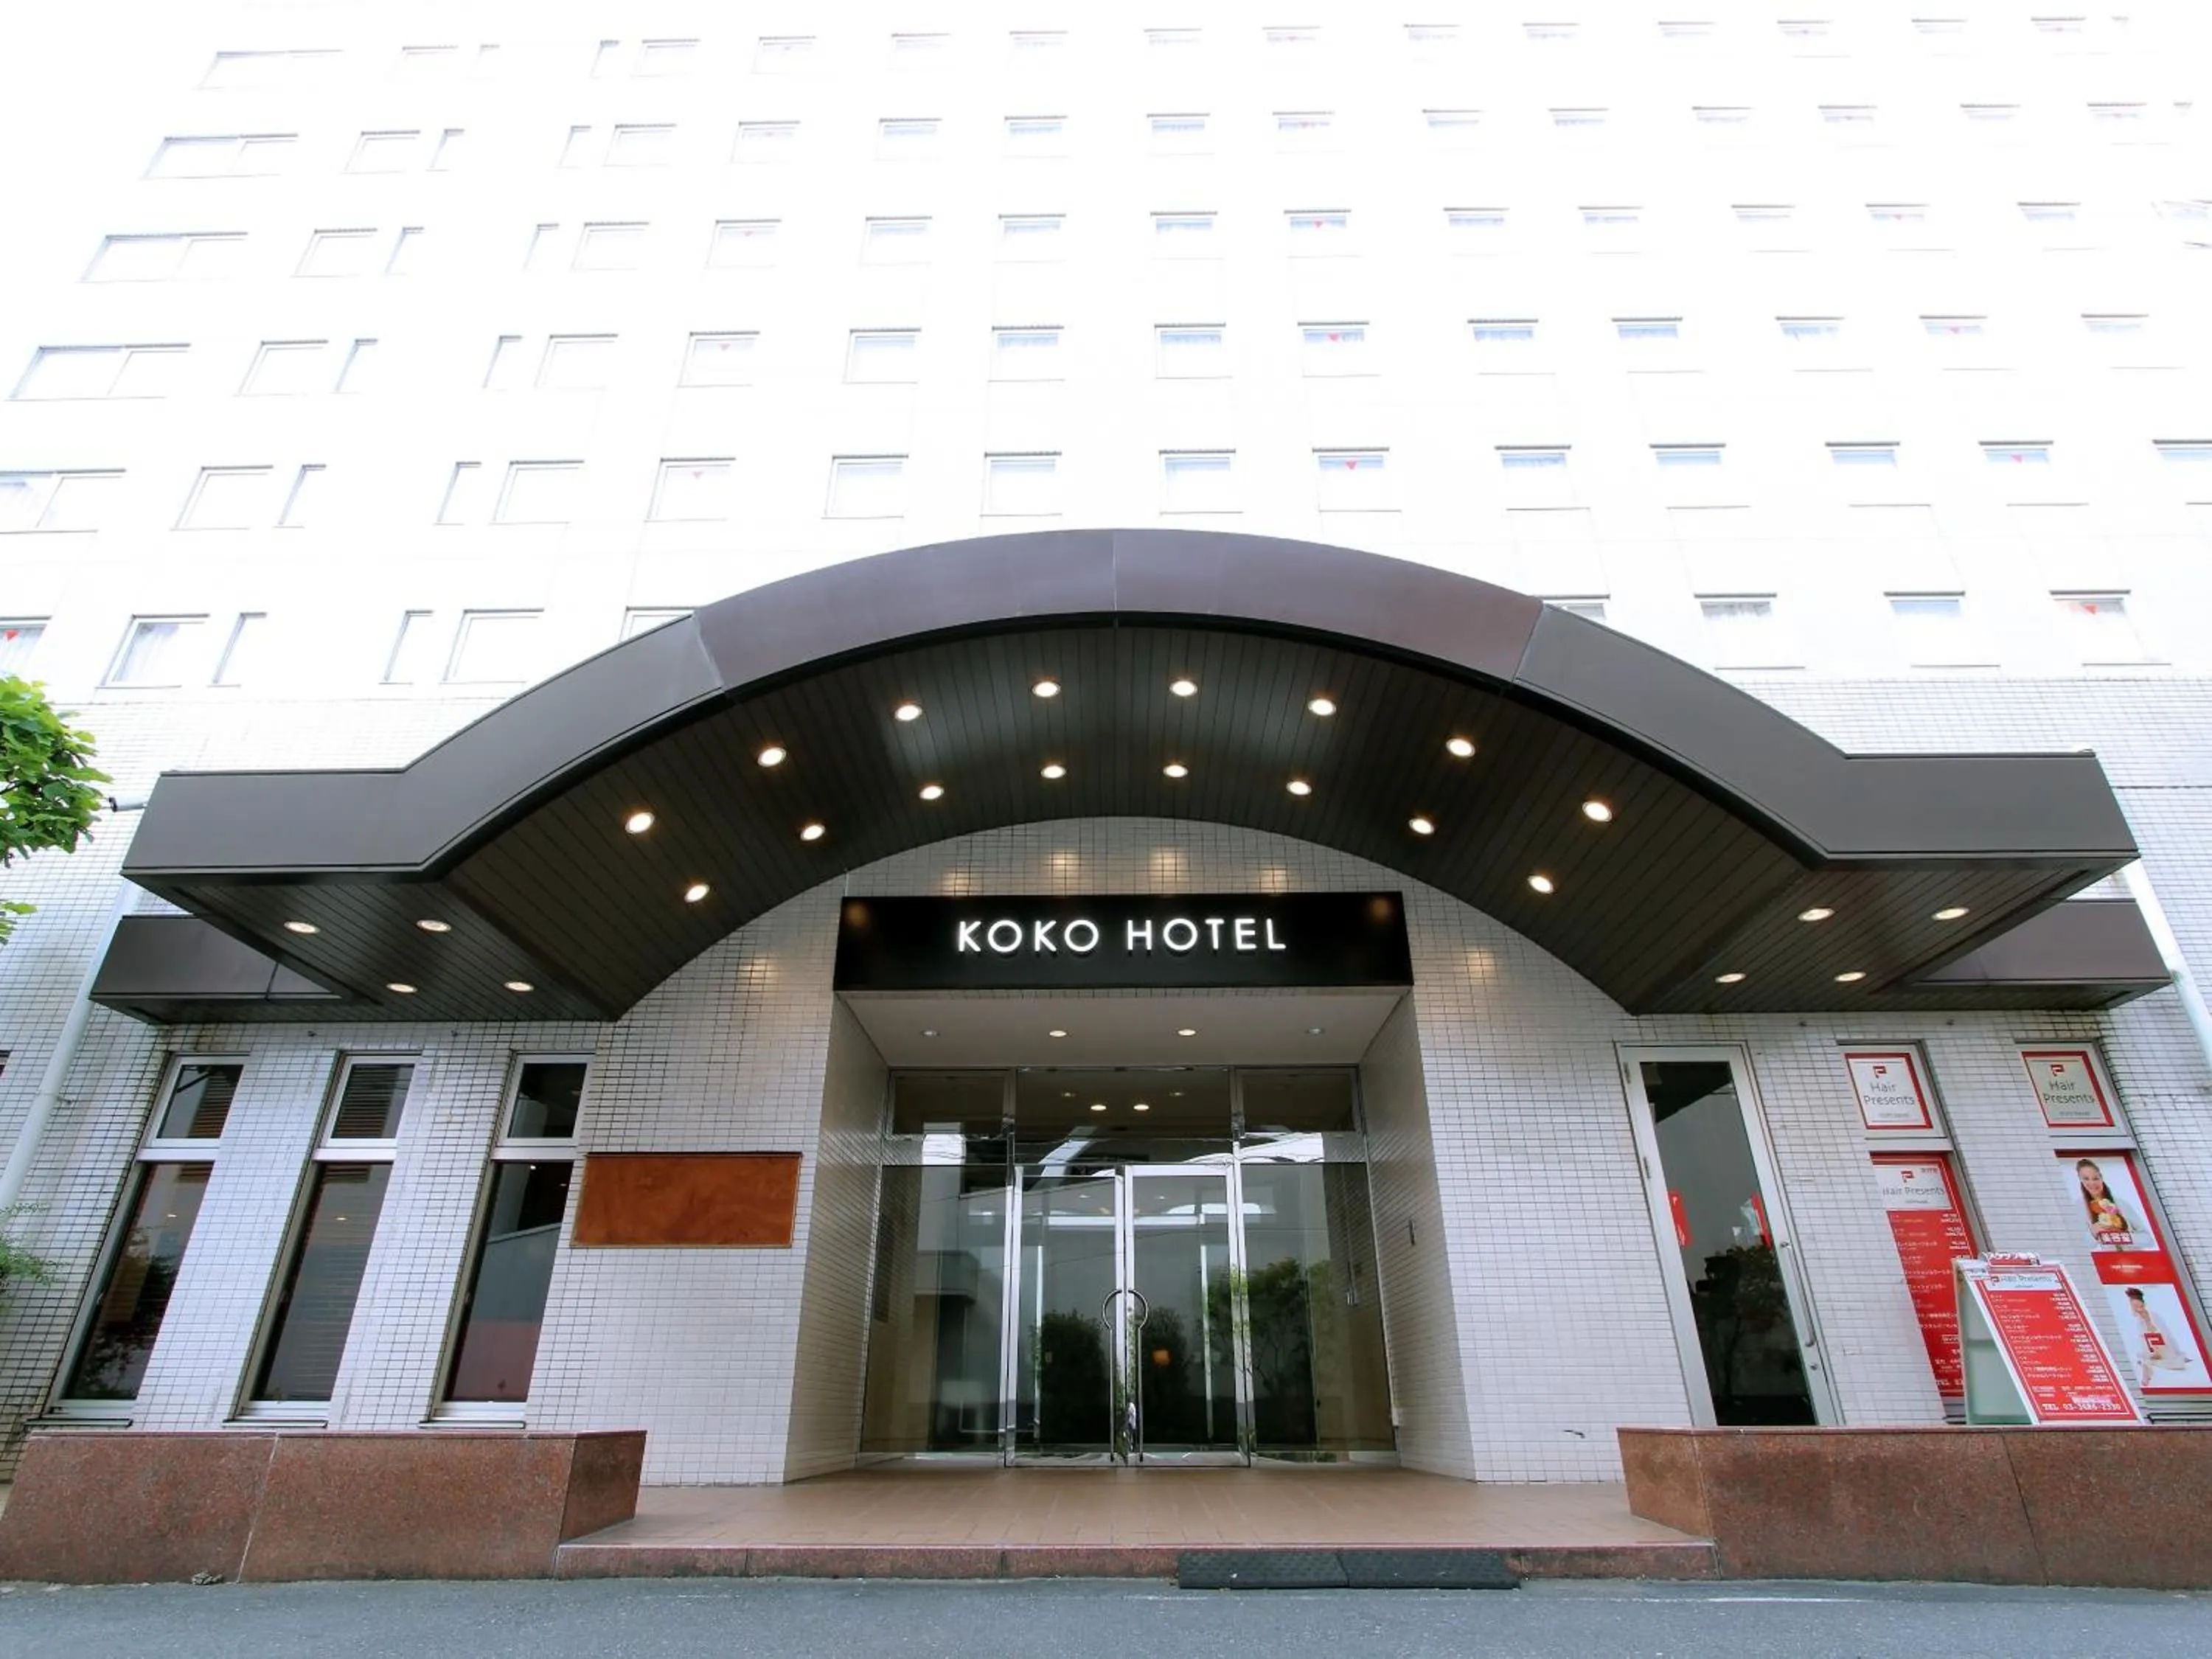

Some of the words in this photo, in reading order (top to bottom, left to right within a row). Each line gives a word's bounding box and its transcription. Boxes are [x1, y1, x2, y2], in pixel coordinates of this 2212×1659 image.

[958, 919, 1099, 952] KOKO
[1127, 918, 1287, 950] HOTEL
[1870, 1081, 1896, 1092] Hair
[2050, 1079, 2075, 1091] Hair
[1864, 1095, 1916, 1105] Presents
[2043, 1093, 2096, 1104] Presents
